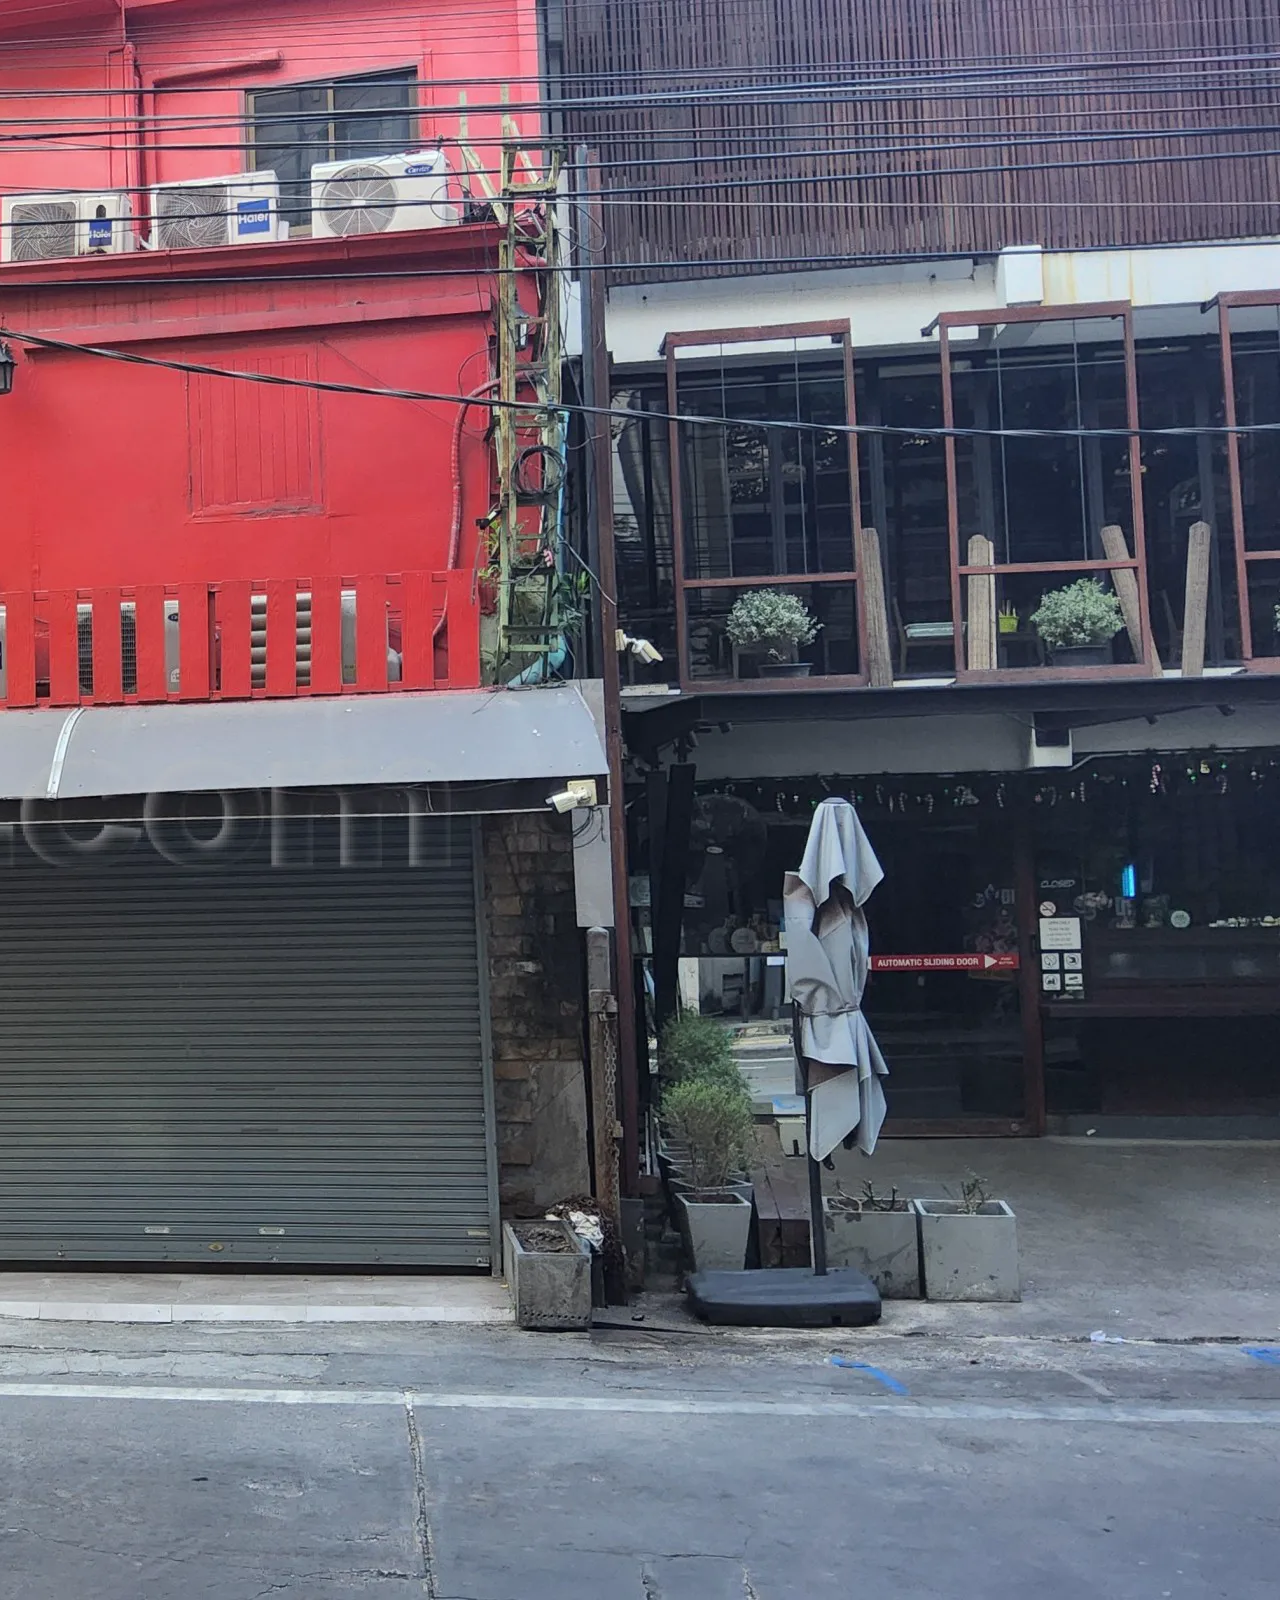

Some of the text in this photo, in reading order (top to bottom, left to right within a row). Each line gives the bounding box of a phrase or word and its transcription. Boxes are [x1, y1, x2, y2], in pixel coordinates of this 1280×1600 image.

[238, 211, 269, 225] Haier
[1040, 879, 1076, 889] CLOSED
[877, 956, 979, 968] AUTOMATIC SLIDING DOOR
